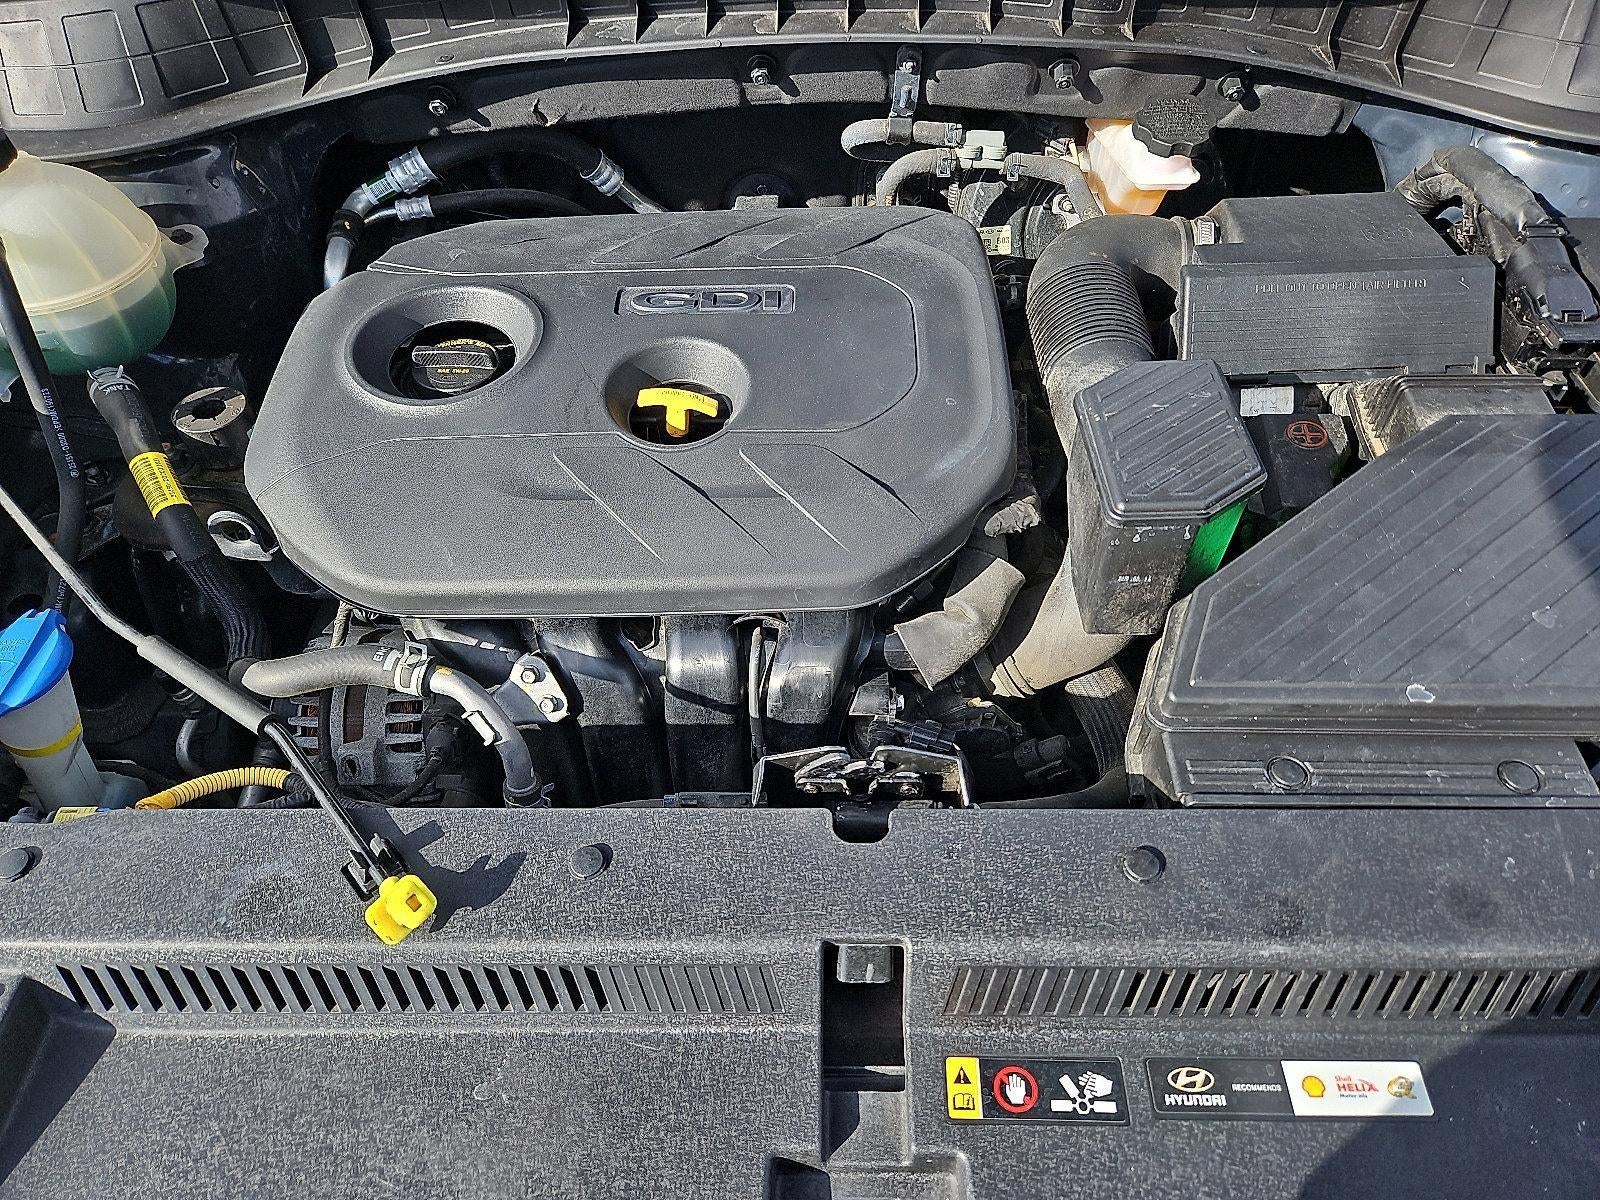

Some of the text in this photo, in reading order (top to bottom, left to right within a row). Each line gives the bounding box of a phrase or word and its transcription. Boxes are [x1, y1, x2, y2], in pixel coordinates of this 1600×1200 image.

[1285, 282, 1306, 292] OUT
[630, 291, 782, 311] GDI
[103, 384, 131, 395] TANK
[1231, 1083, 1378, 1093] RECOMMENDS HELIX
[1164, 1093, 1227, 1107] HYUNDAI
